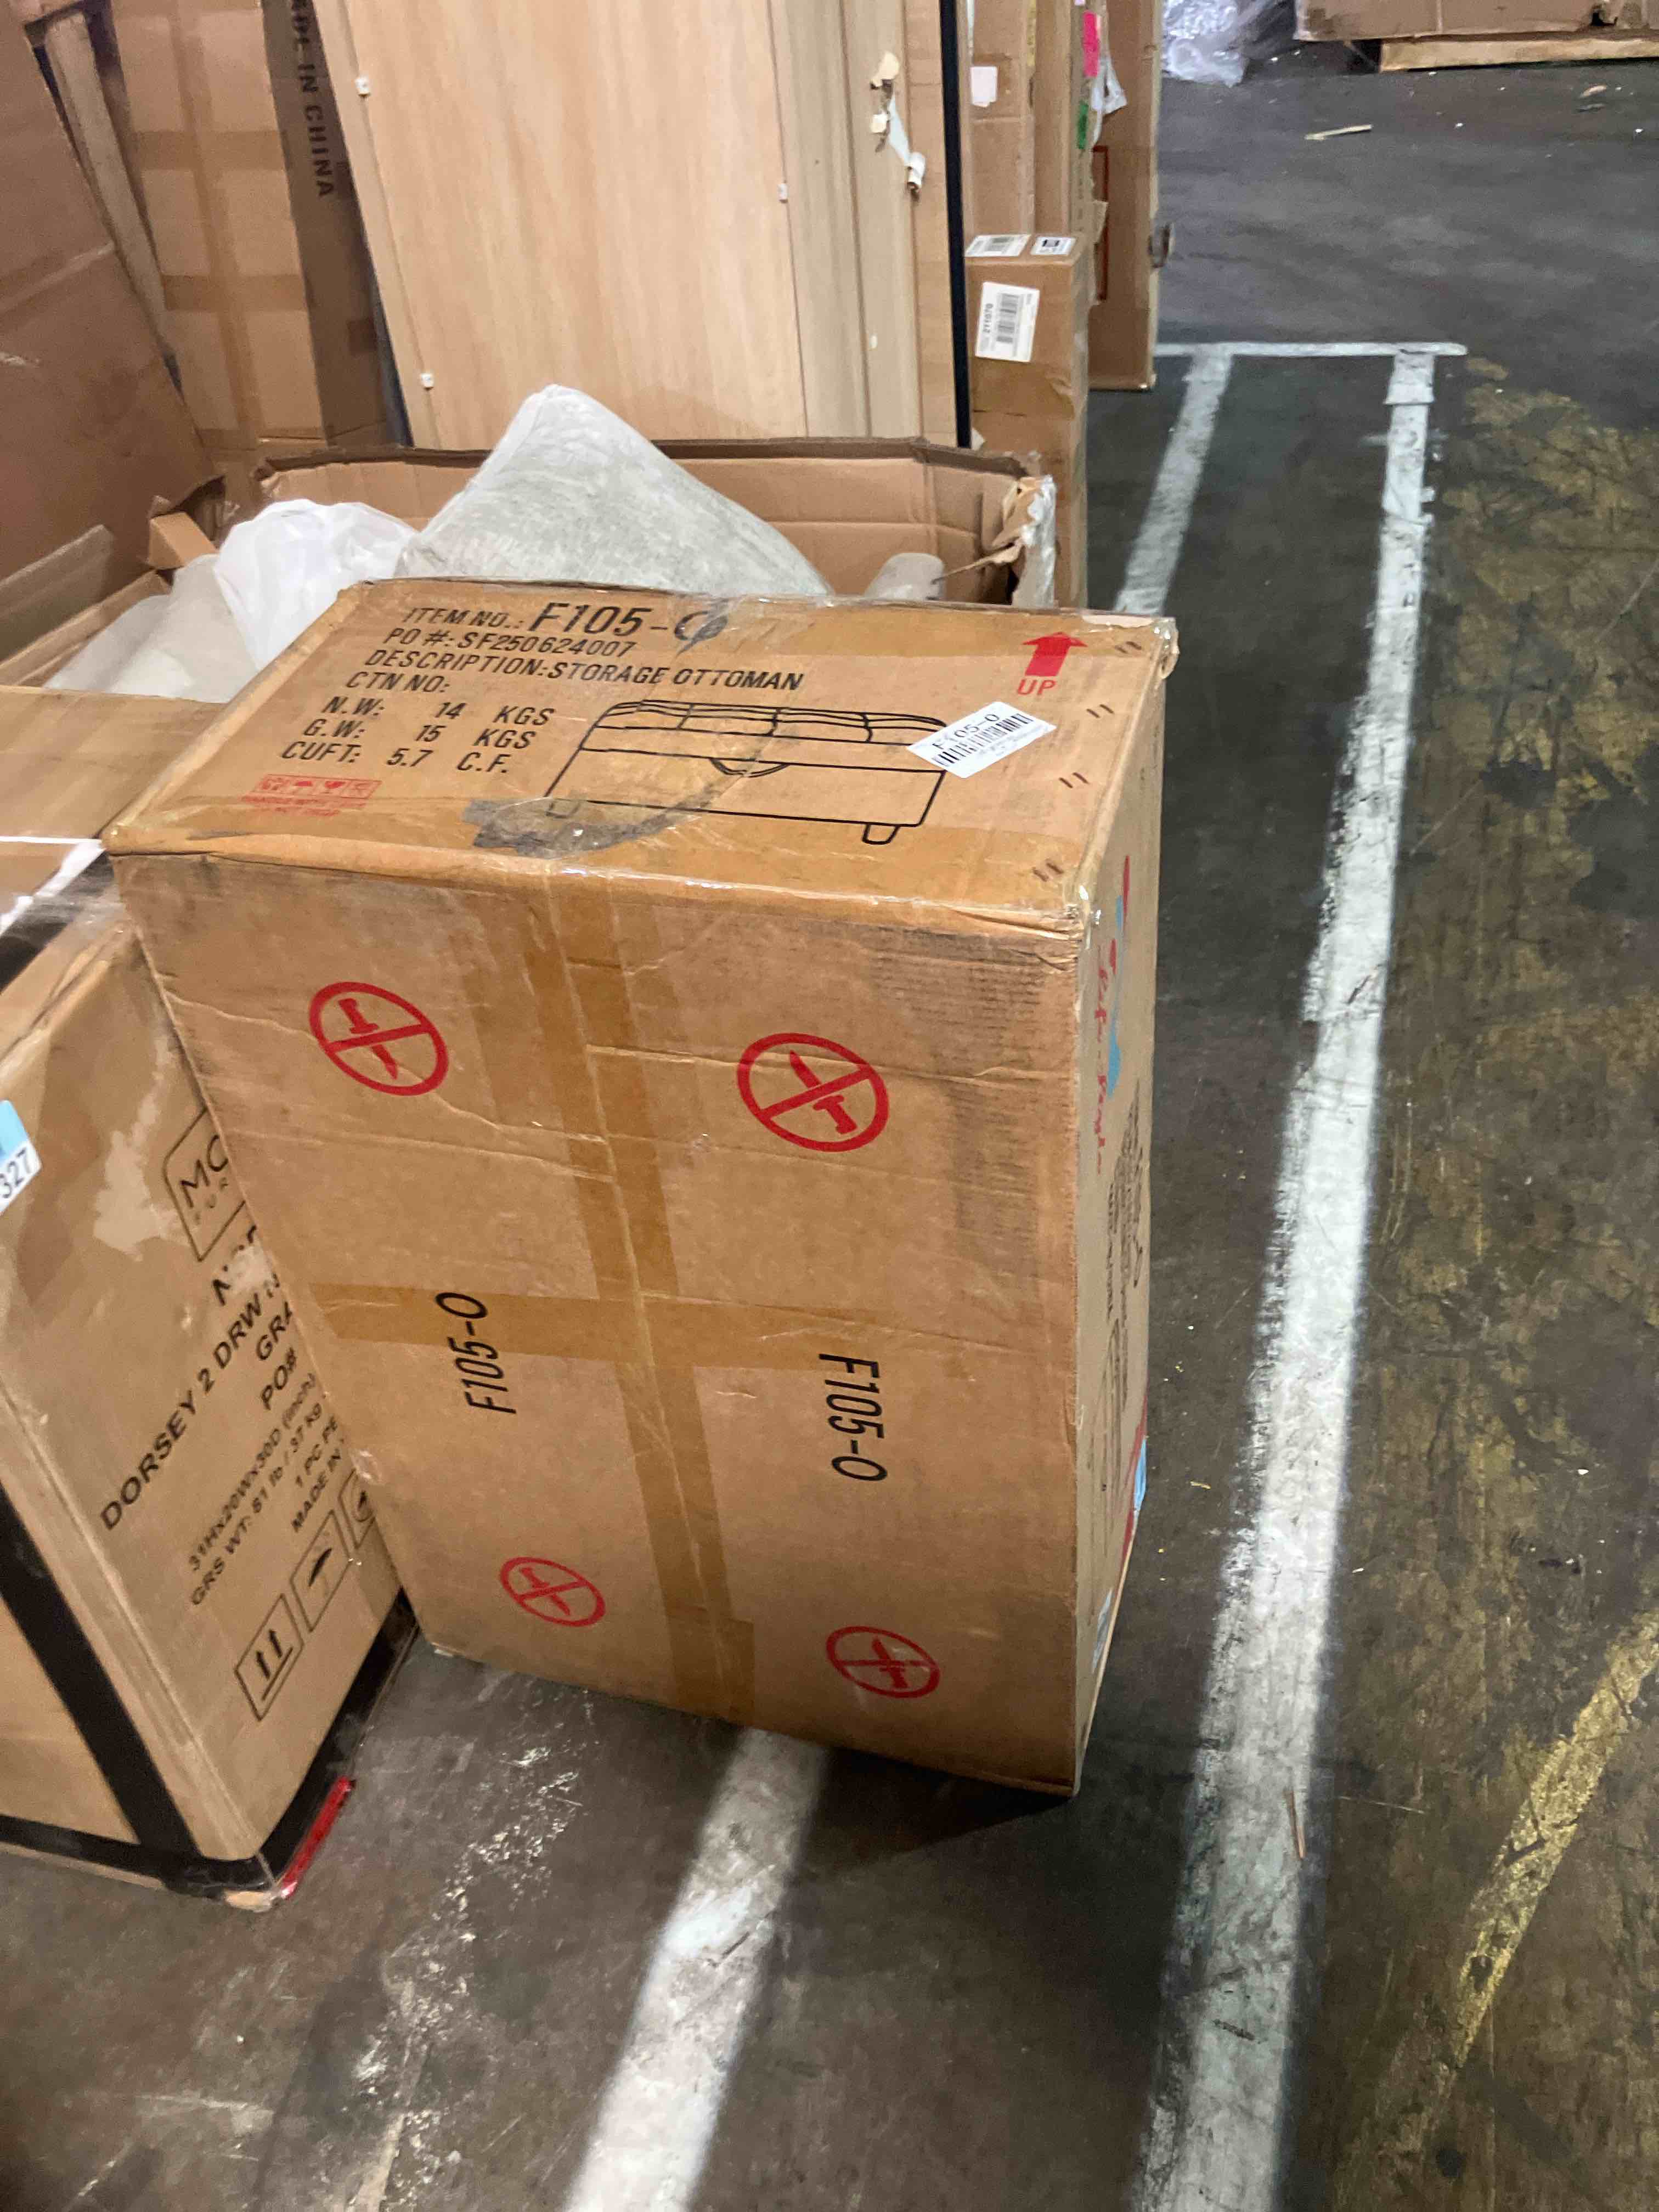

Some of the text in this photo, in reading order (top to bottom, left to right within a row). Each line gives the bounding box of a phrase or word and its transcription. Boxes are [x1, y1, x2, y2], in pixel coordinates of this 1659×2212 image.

[297, 63, 319, 93] IN
[304, 105, 334, 198] CHINA
[403, 607, 470, 625] ITEM
[382, 628, 421, 645] PO
[457, 631, 637, 658] SF250624007
[346, 671, 451, 692] CTN NO:
[674, 668, 804, 691] OTTOMAN
[1017, 679, 1057, 696] UP
[435, 702, 467, 719] 14
[493, 706, 554, 725] KGS
[415, 725, 447, 742] 15
[473, 729, 536, 748] KGS
[282, 741, 511, 773] CUFT: 5.7 C.F.
[261, 1347, 297, 1411] PO#
[100, 1390, 195, 1531] DORSEY
[197, 1368, 215, 1394] 2
[213, 1293, 262, 1369] DRW
[292, 1448, 341, 1534] MADE IN
[192, 1557, 225, 1605] GRS
